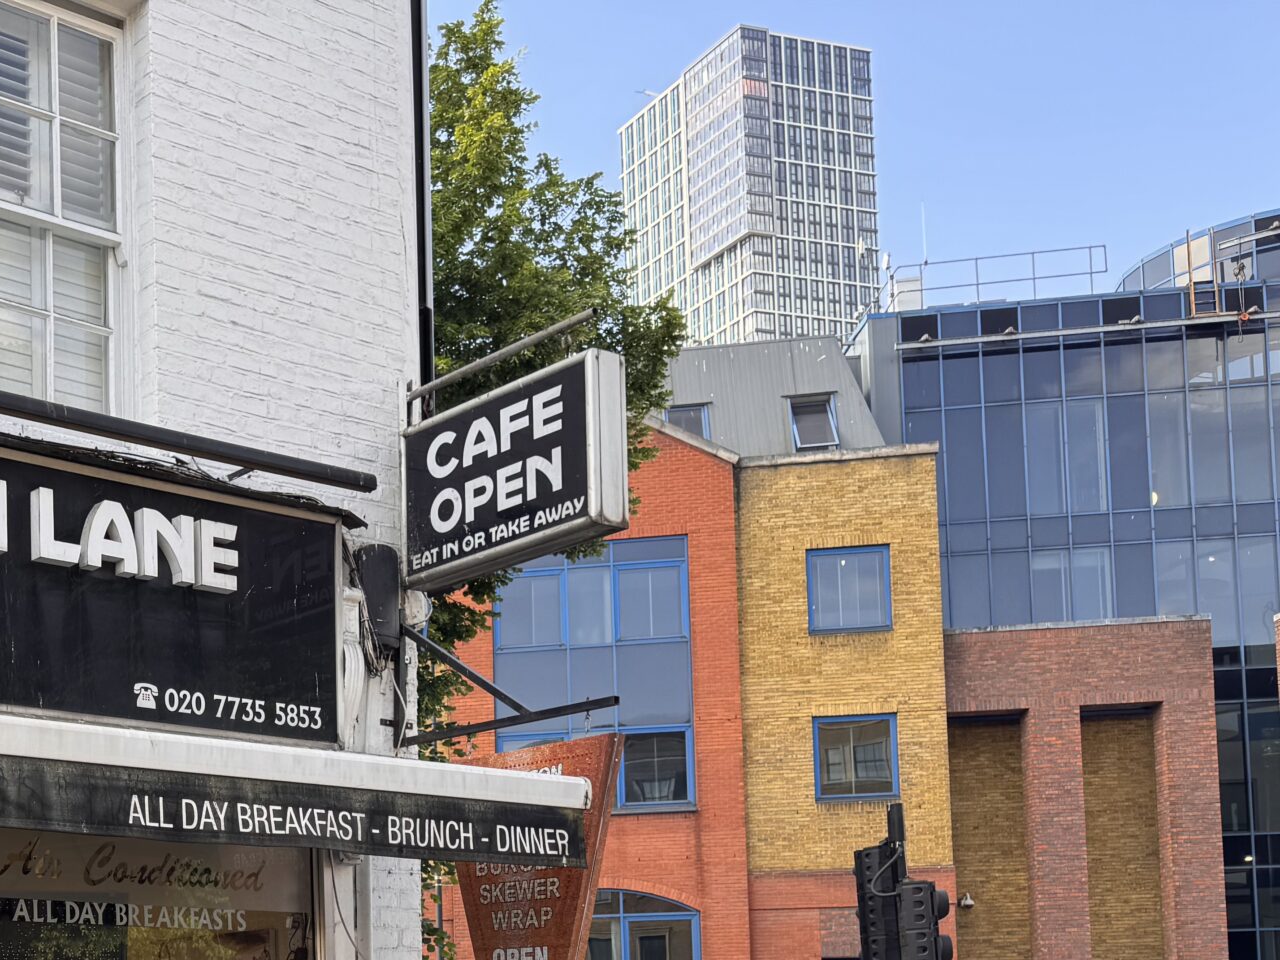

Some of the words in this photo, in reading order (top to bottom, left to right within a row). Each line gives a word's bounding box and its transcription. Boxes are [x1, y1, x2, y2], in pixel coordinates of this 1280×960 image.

[426, 384, 563, 479] CAFE
[430, 445, 563, 534] OPEN
[30, 487, 239, 594] LANE
[412, 546, 439, 570] EAT
[441, 538, 460, 559] IN
[462, 530, 486, 551] OR
[489, 516, 531, 544] TAKE
[533, 496, 586, 530] AWAY
[164, 689, 206, 717] 020
[213, 694, 267, 724] 7735
[274, 703, 322, 730] 5853
[128, 794, 174, 829] ALL
[181, 798, 230, 832] DAY
[237, 801, 367, 843] BREAKFAST
[387, 814, 474, 851] BRUNCH
[496, 825, 570, 857] DINNER
[83, 841, 266, 892] Conditioned
[479, 877, 561, 905] SKEWER
[12, 898, 60, 924] ALL
[65, 901, 107, 925] DAY
[116, 904, 247, 932] BREAKFASTS
[491, 907, 553, 931] WRAP
